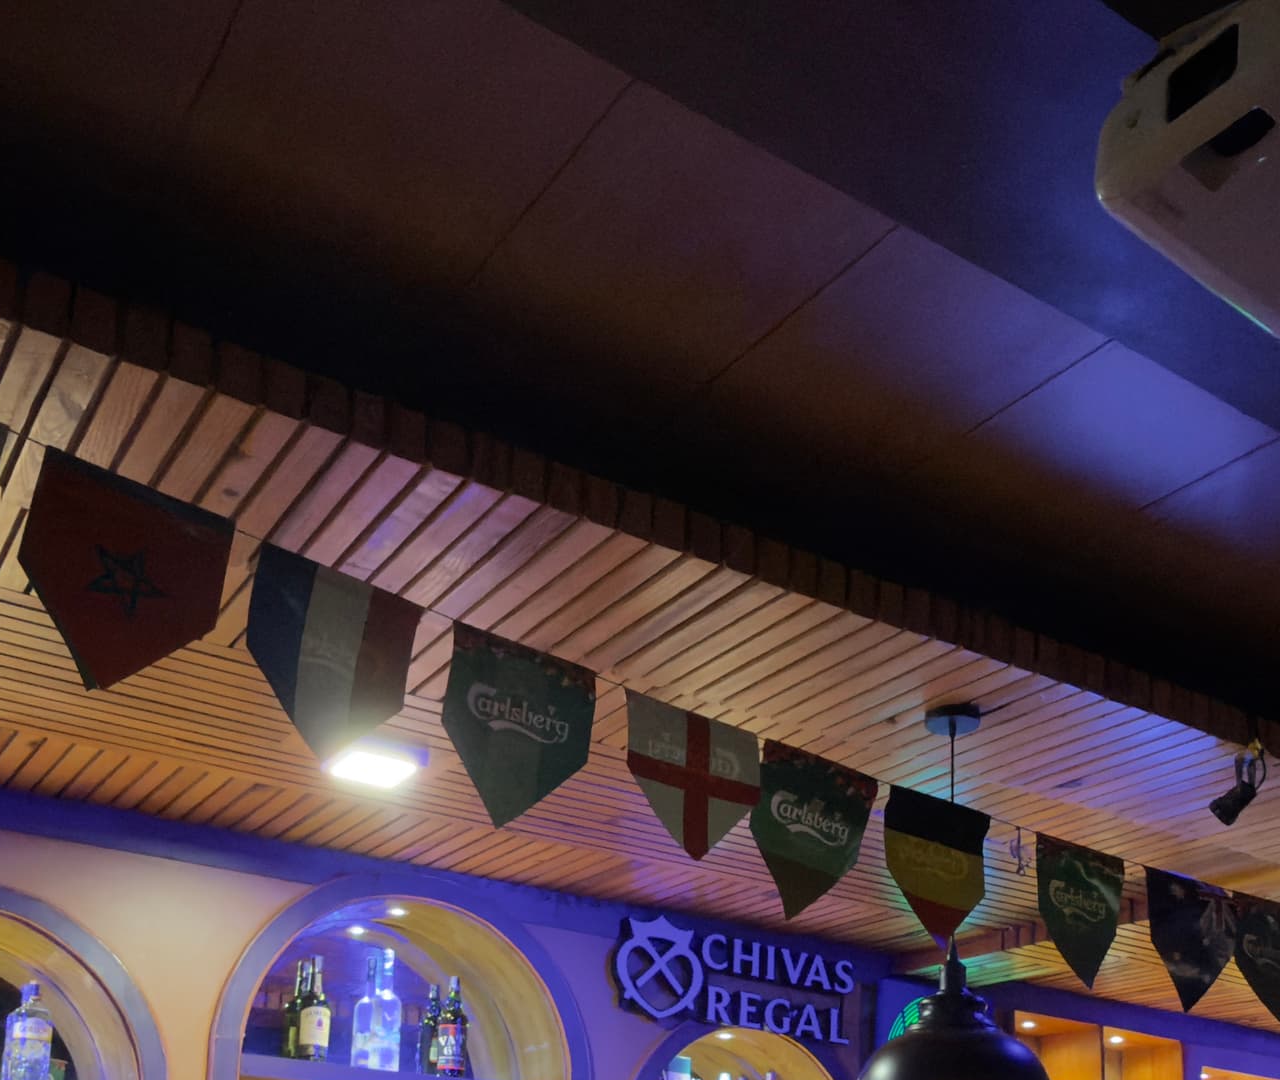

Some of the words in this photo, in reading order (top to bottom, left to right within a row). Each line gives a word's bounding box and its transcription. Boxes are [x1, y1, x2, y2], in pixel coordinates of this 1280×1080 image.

[466, 680, 570, 745] Carlsberg
[770, 789, 851, 848] Carlsberg
[701, 933, 855, 995] CHIVAS
[706, 984, 851, 1045] REGAL
